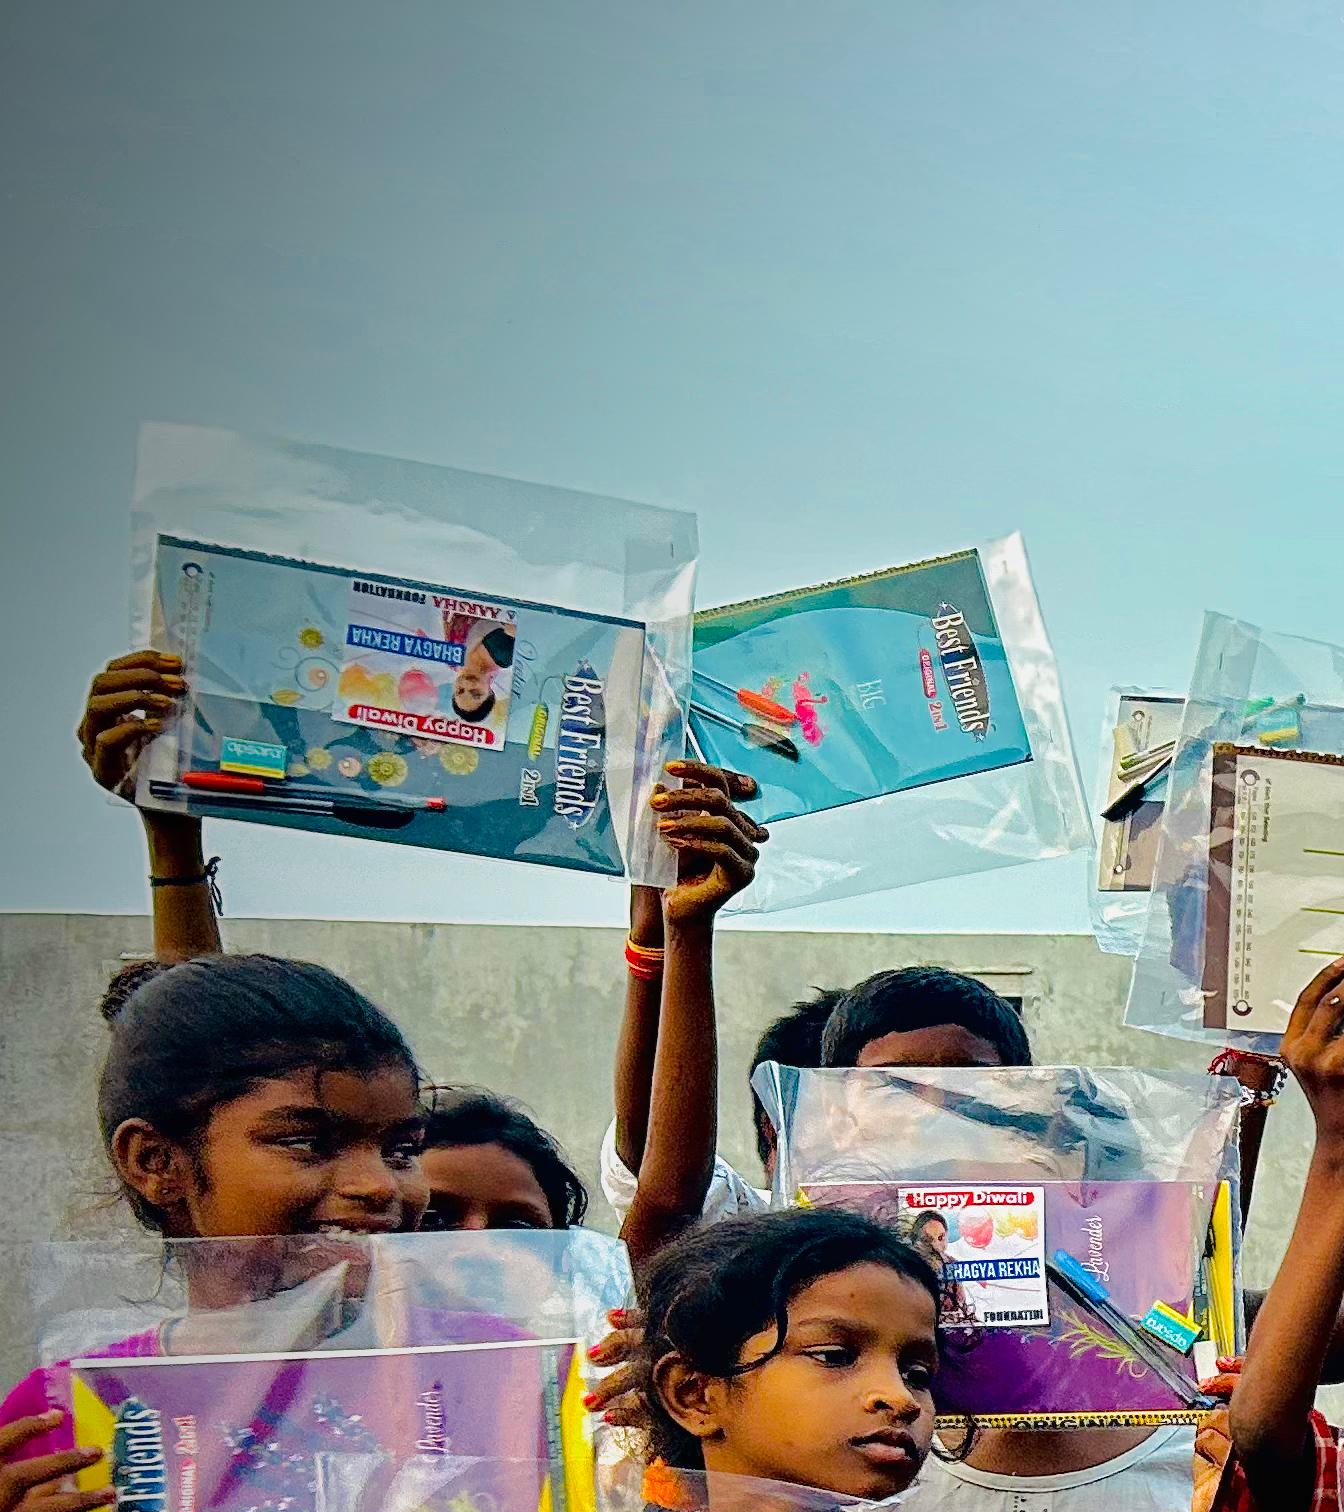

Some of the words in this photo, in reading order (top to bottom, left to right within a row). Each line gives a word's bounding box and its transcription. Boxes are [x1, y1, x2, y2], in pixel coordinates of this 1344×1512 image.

[433, 595, 499, 619] AARSHA
[350, 627, 402, 646] REKHA
[931, 612, 963, 655] Best
[404, 638, 463, 663] BHAGYA
[559, 675, 604, 729] Best
[944, 656, 990, 732] Friends
[356, 706, 419, 731] Diwali
[422, 719, 487, 744] Happy
[554, 729, 601, 816] Friends
[912, 1192, 970, 1207] Happy
[973, 1190, 1027, 1205] Diwali
[1086, 1215, 1109, 1282] Lavender
[946, 1263, 996, 1279] BHAGYA
[999, 1260, 1040, 1277] REKHA
[114, 1409, 167, 1502] Friends
